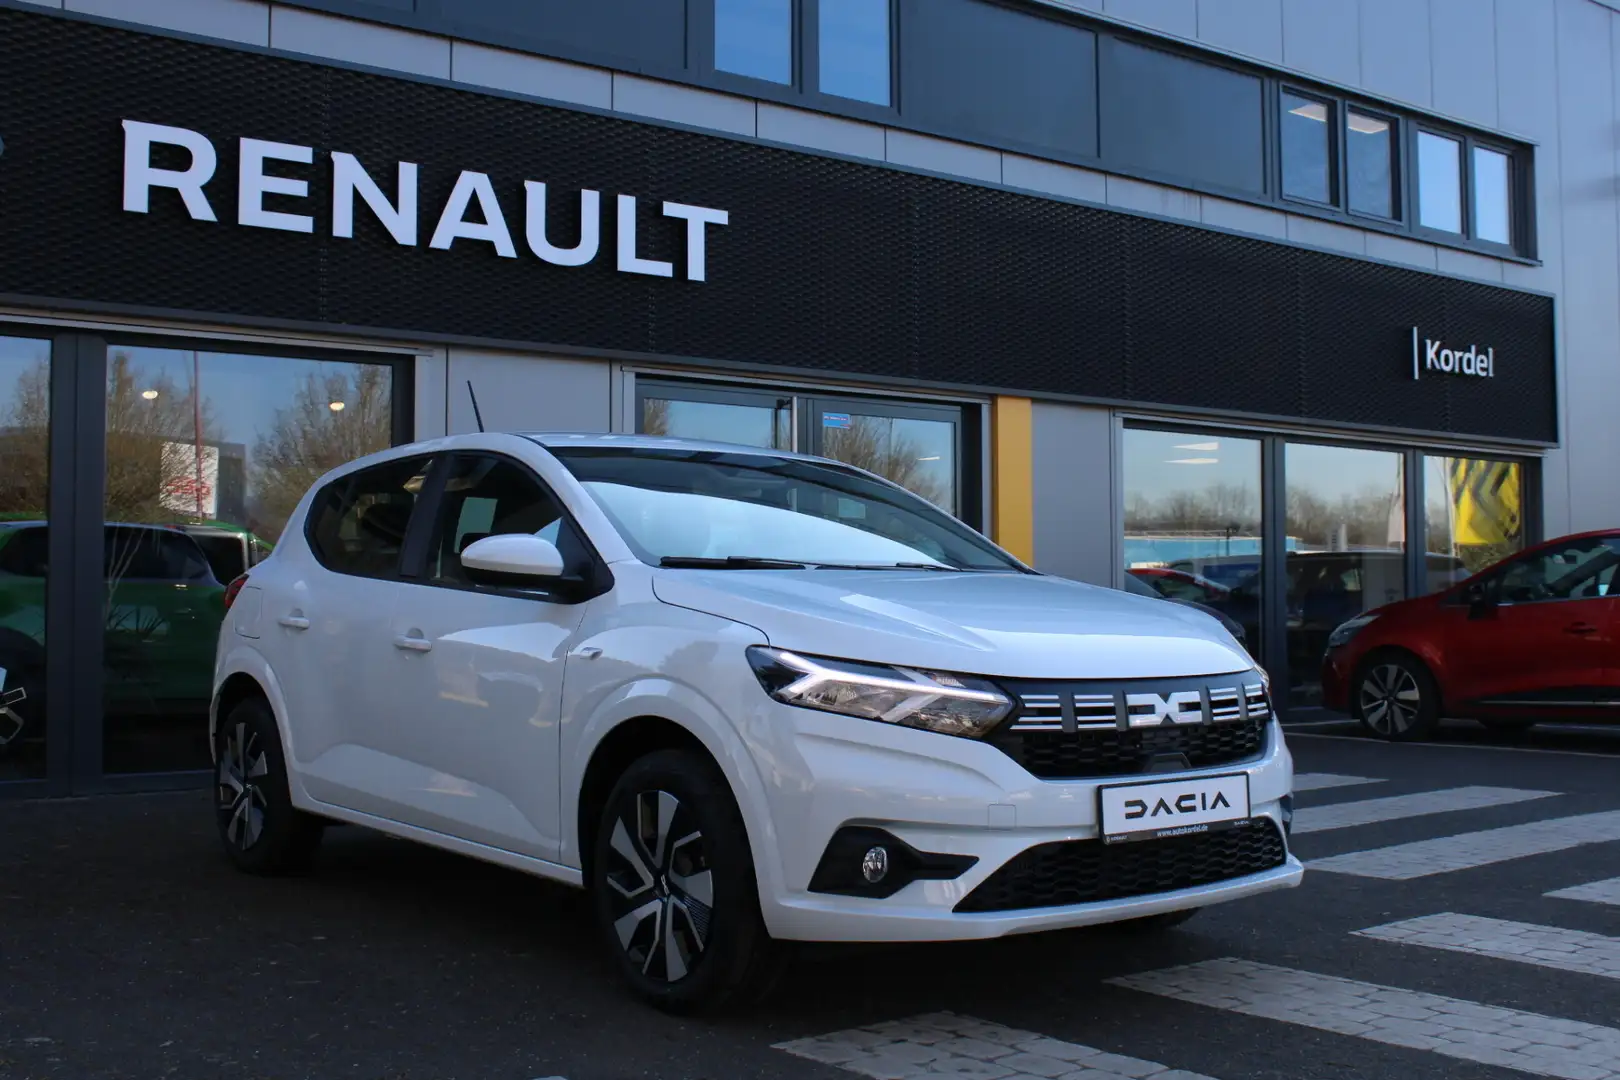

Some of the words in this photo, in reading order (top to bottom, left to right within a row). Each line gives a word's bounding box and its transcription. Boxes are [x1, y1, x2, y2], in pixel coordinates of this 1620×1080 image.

[121, 119, 729, 282] RENAULT
[1425, 339, 1494, 377] Kordel
[1124, 791, 1231, 819] DACIA
